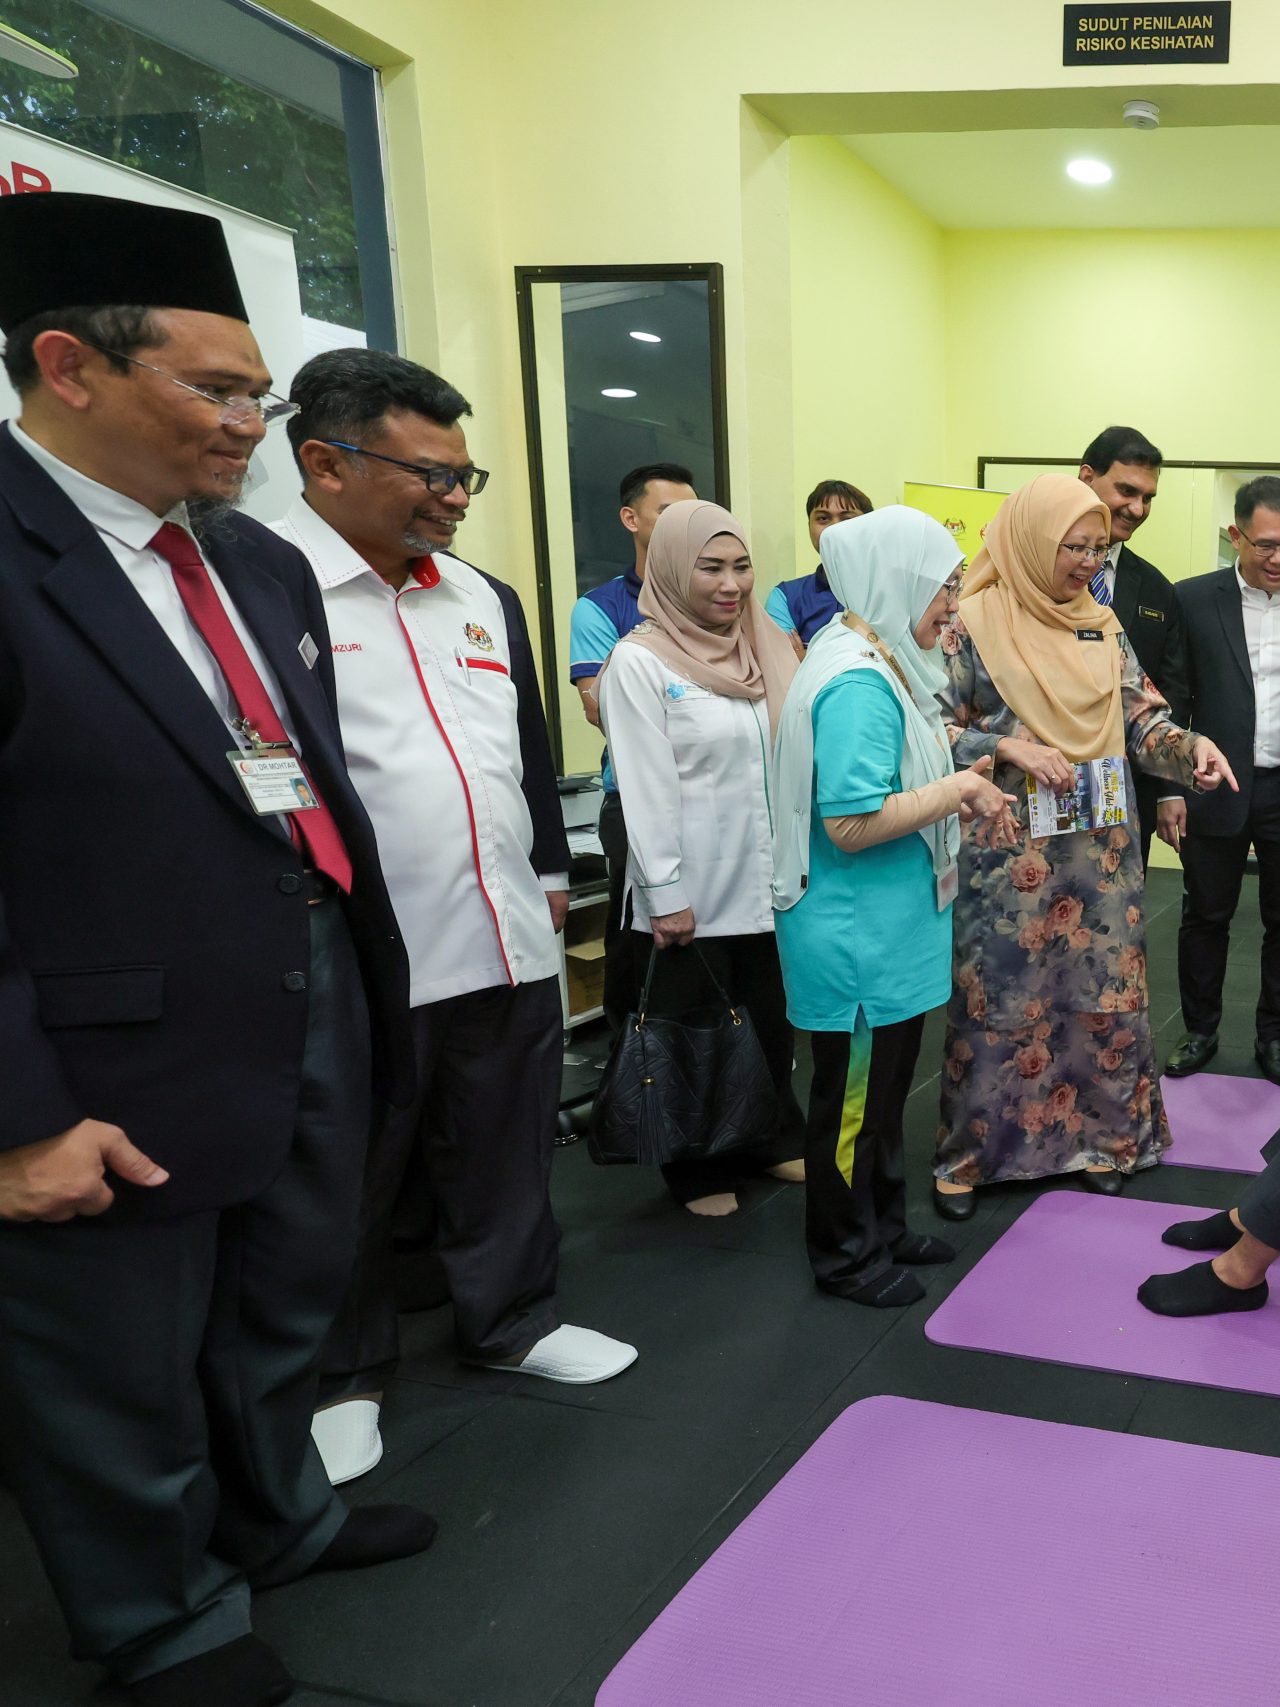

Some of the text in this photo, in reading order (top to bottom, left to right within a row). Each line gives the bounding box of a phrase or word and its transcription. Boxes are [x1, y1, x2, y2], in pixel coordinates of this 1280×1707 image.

[1078, 15, 1213, 32] SUDUT PENILAIAN
[1076, 35, 1215, 51] RISIKO KESIHATAN
[329, 643, 362, 653] MZURI
